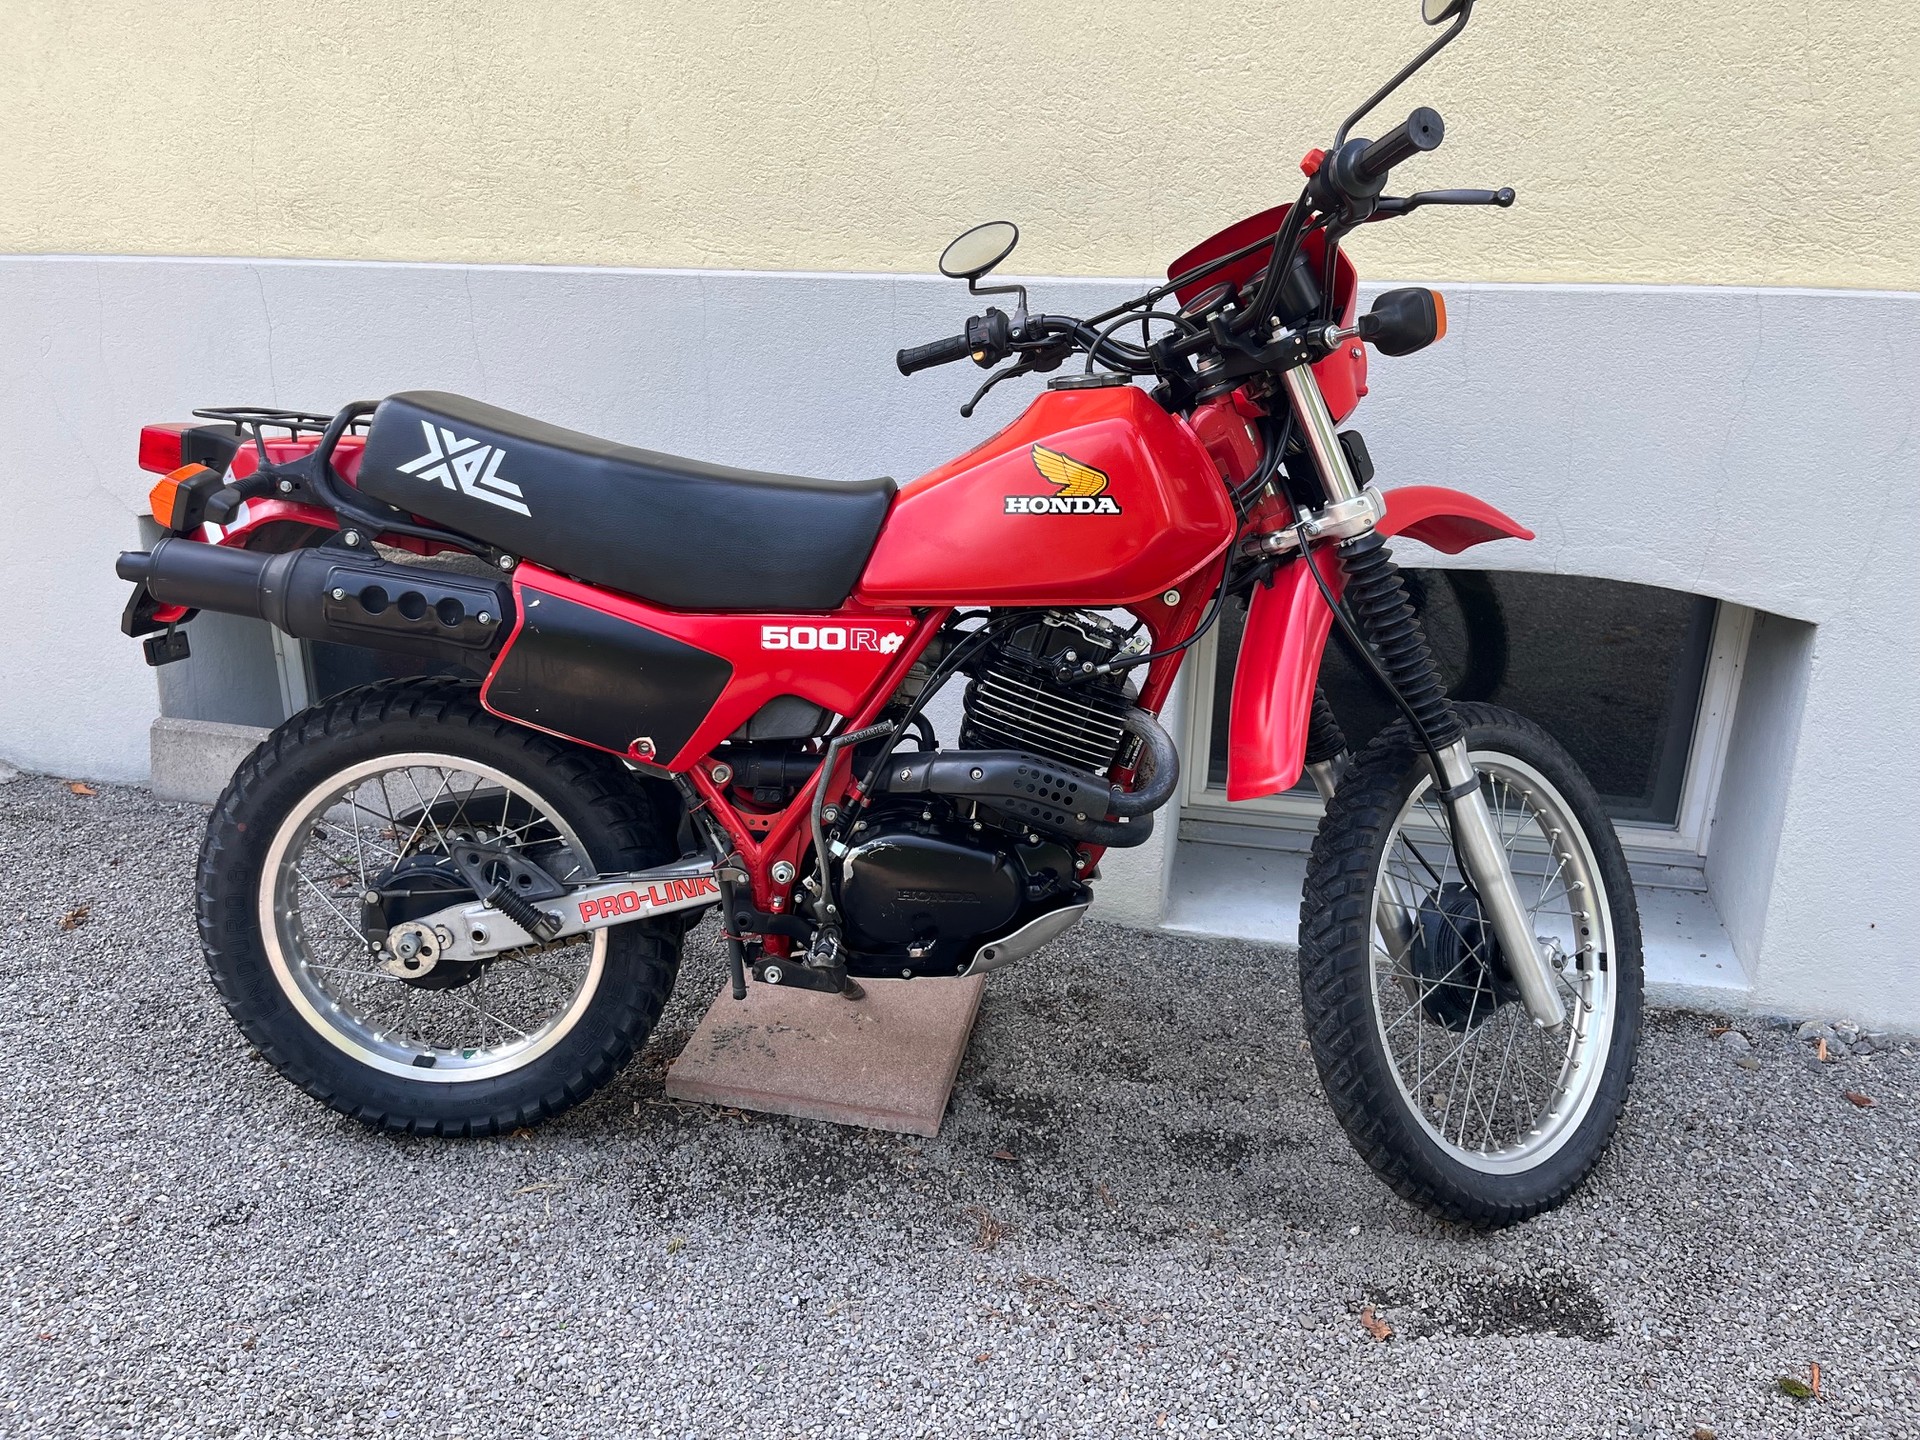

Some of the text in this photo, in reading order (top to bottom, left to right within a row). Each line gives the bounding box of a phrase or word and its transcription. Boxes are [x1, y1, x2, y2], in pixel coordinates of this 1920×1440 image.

[1004, 496, 1121, 514] HONDA
[578, 876, 720, 924] PRO-LINK
[225, 893, 281, 1020] ENDURO
